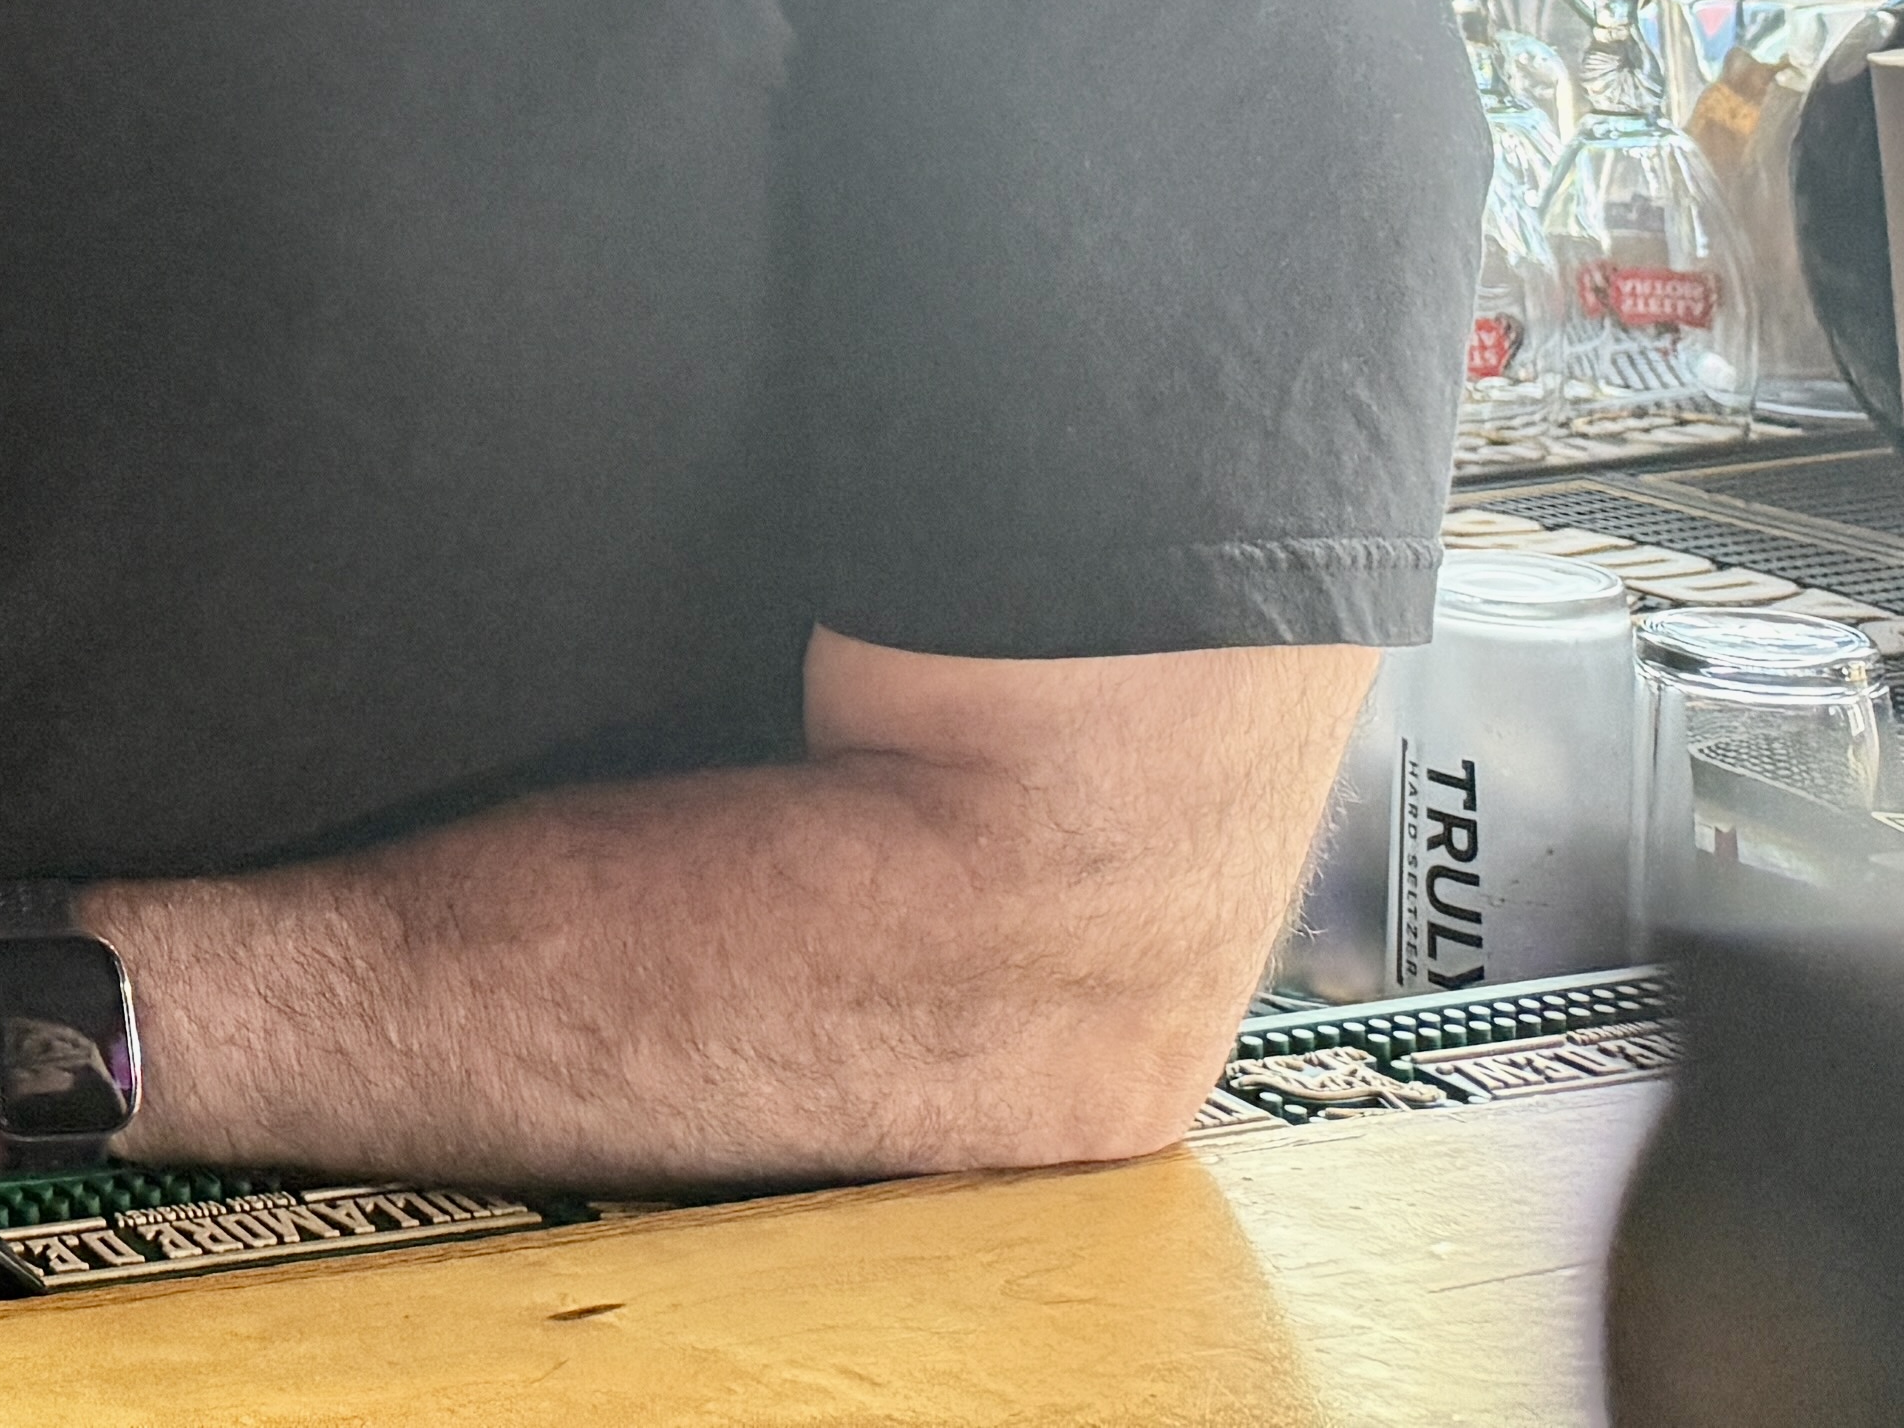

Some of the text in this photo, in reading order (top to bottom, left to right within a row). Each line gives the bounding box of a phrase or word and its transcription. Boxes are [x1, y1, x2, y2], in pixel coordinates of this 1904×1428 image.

[1406, 759, 1420, 978] HARD SELTZER
[1425, 759, 1486, 990] TRULY
[115, 1190, 298, 1228] IRISH WHISKEY
